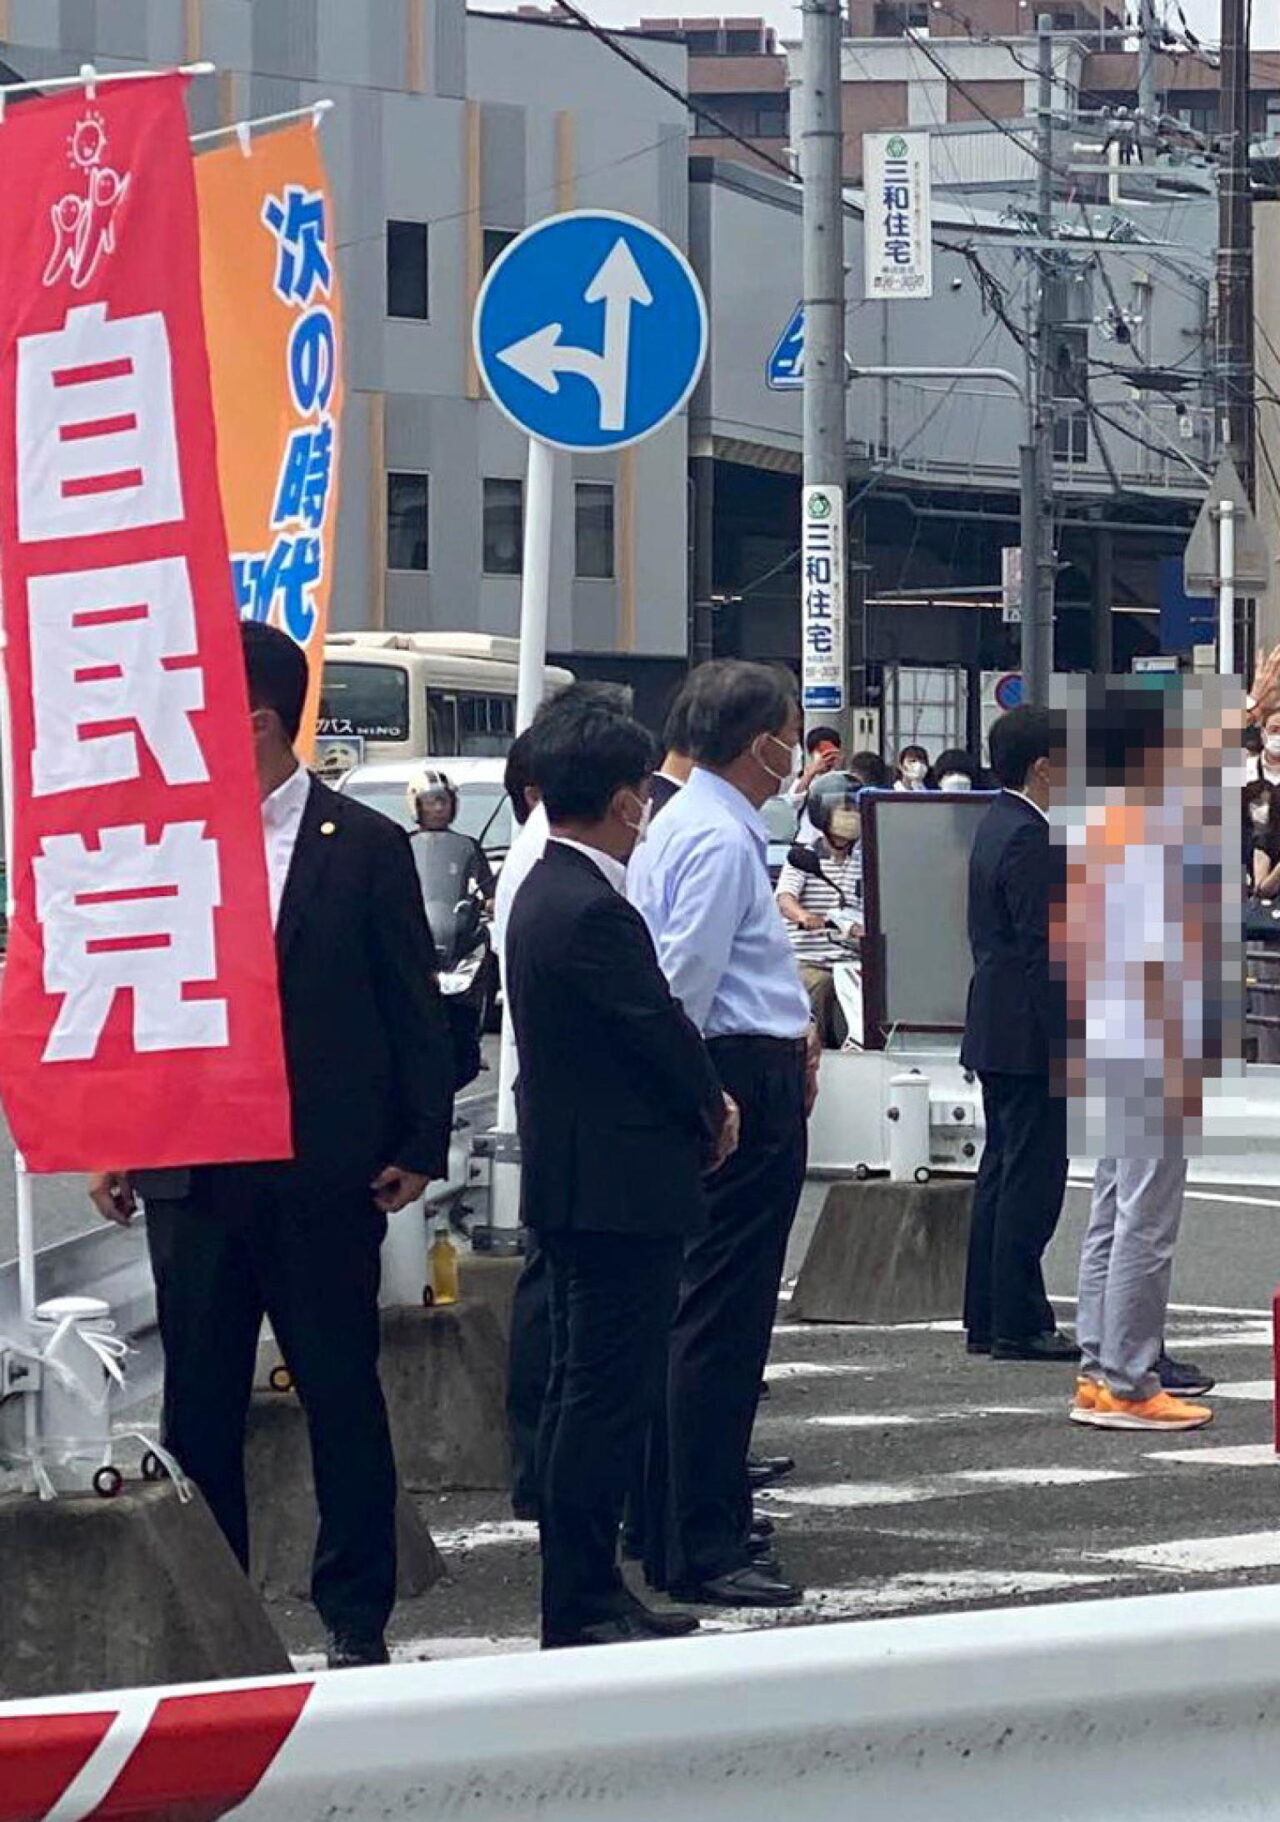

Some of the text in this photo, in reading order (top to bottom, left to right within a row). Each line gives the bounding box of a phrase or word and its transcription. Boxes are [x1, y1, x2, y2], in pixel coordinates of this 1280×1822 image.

[883, 160, 911, 264] 三和住宅
[806, 524, 832, 654] 三和住宅
[17, 301, 229, 1063] 自民党
[356, 726, 401, 736] HINO
